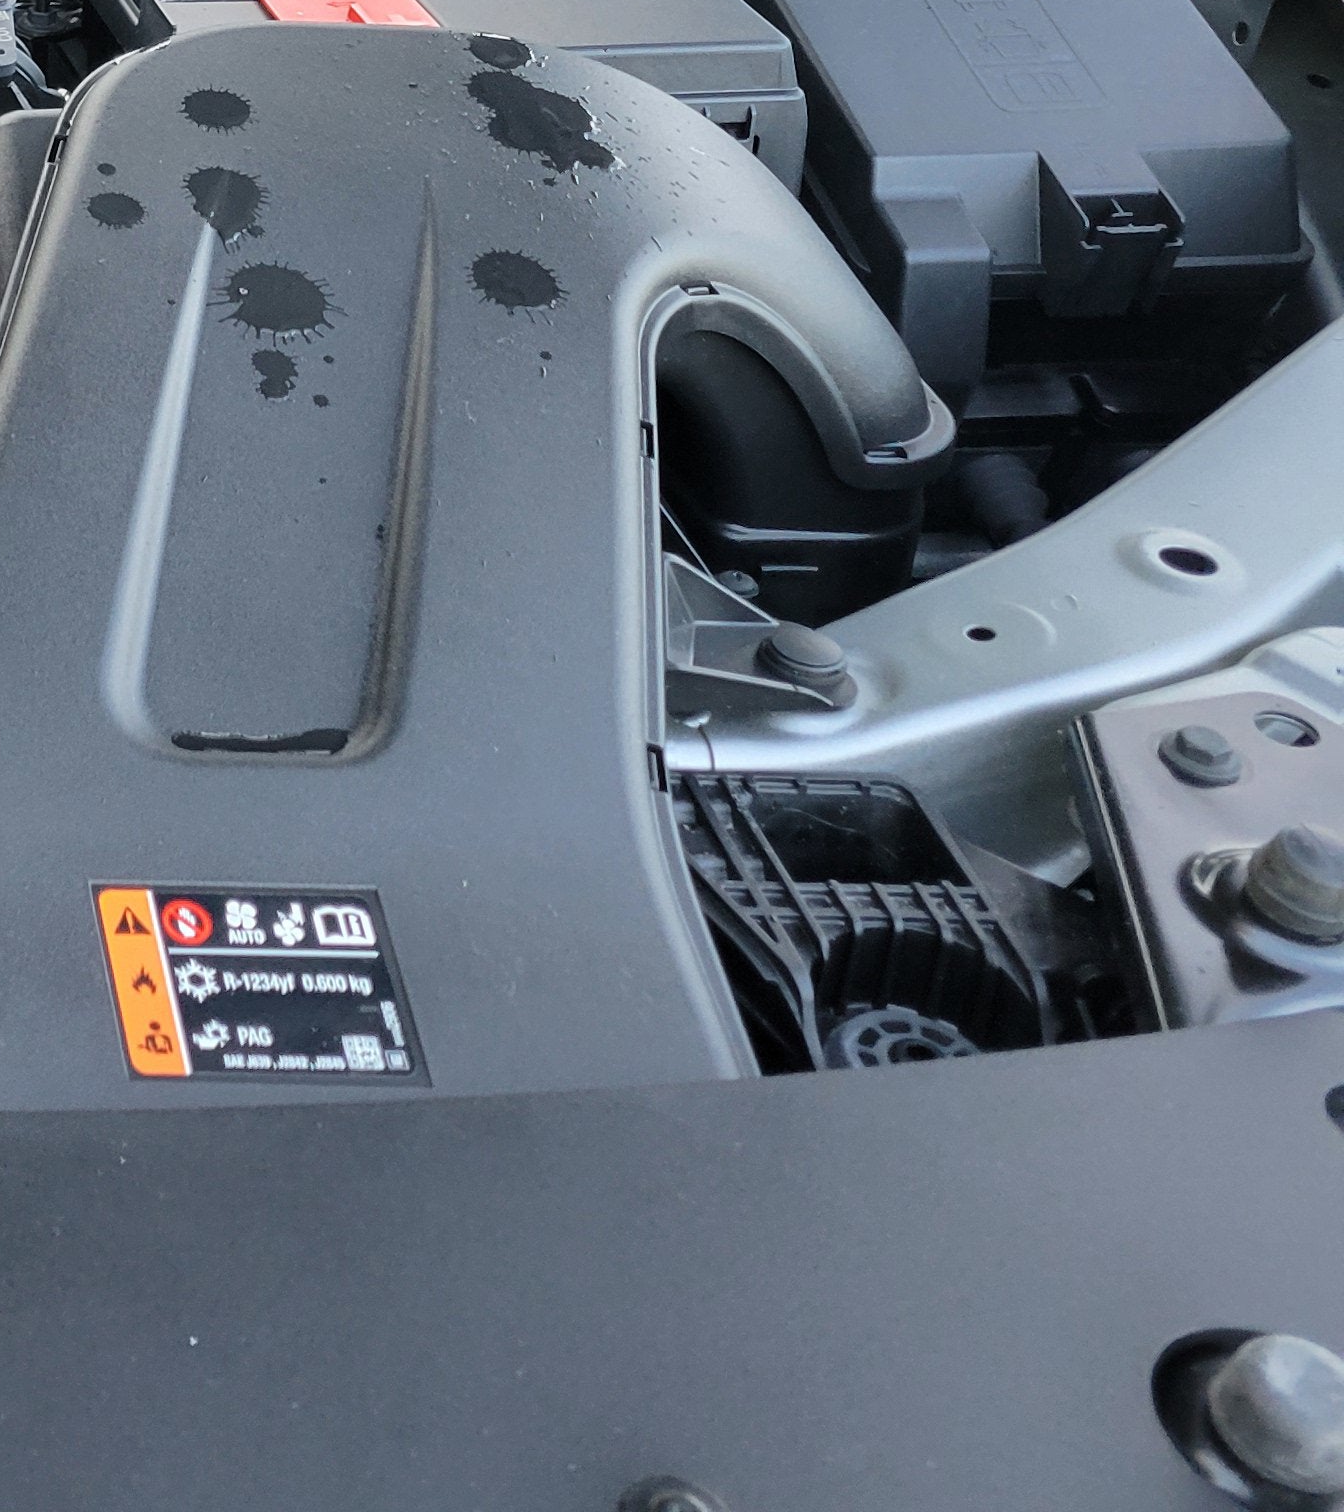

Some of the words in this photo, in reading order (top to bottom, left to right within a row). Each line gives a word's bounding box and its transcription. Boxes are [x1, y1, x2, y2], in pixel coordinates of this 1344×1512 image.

[228, 927, 267, 945] AUTO
[222, 971, 295, 995] R-1234yf
[348, 973, 374, 996] kg
[236, 1025, 274, 1048] PAG
